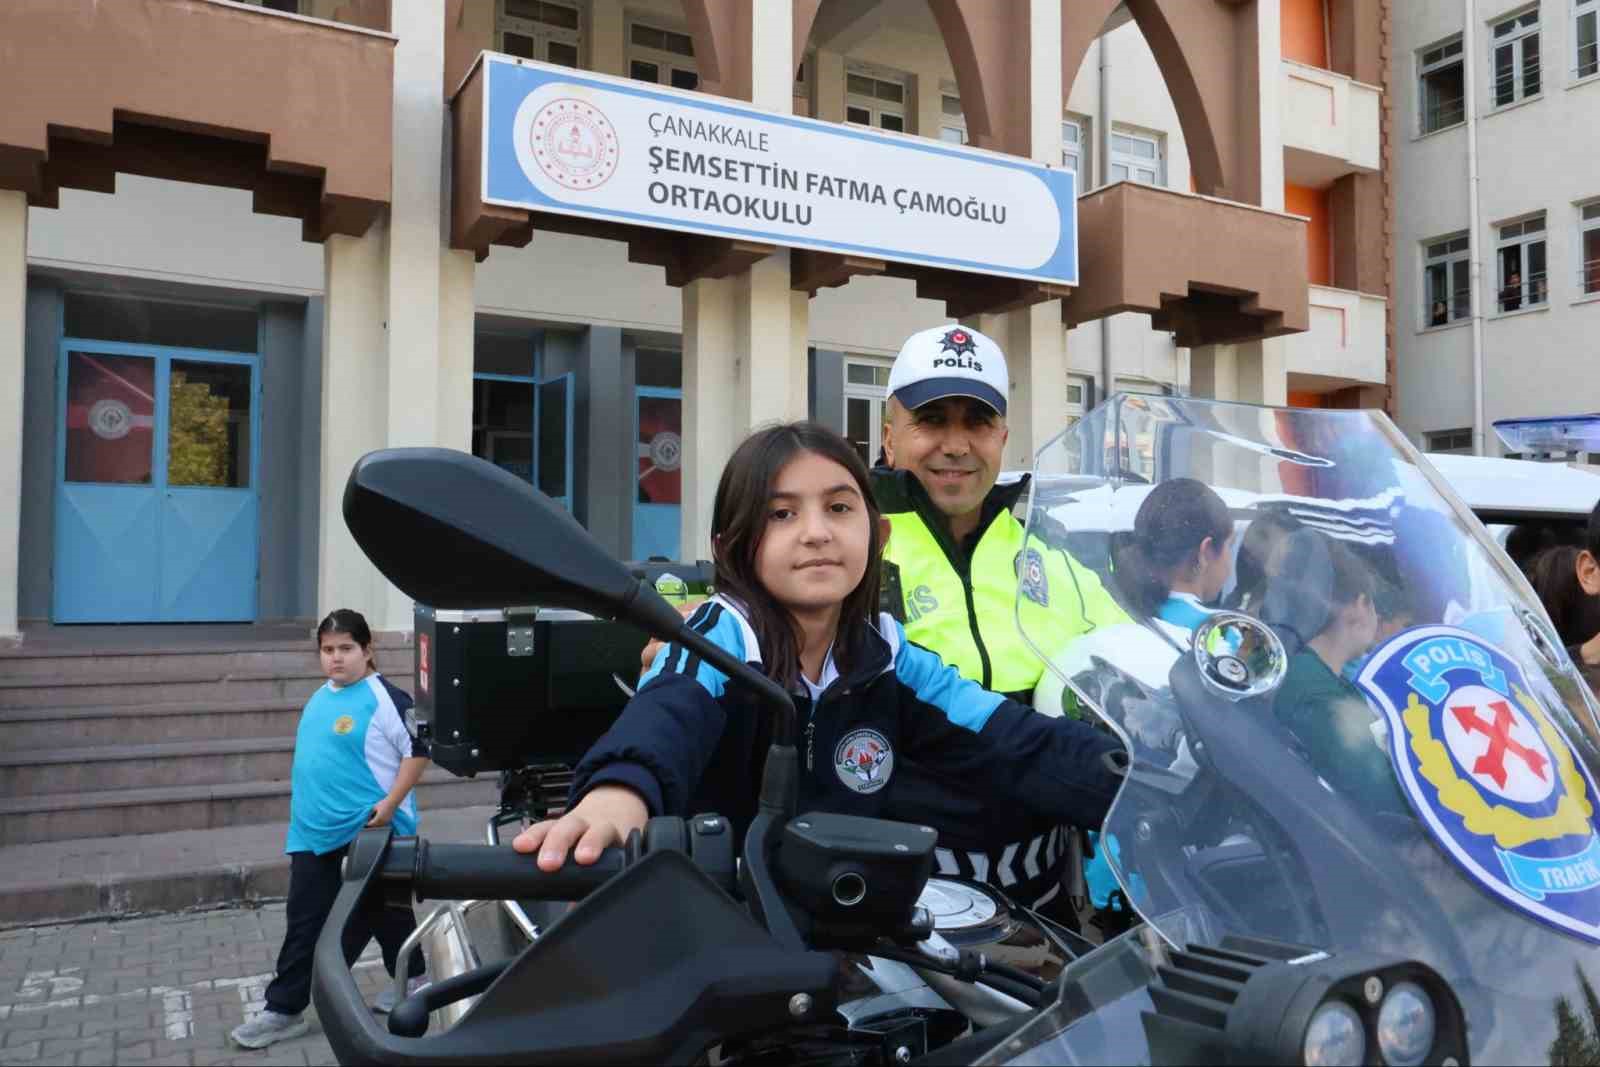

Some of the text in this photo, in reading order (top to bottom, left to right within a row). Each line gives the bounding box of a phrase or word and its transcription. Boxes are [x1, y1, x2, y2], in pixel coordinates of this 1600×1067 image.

[648, 112, 769, 153] ÇANAKKALE
[648, 146, 1007, 225] ŞEMSETTİN FATMA ÇAMOĞLU
[648, 181, 812, 226] ORTAOKULU
